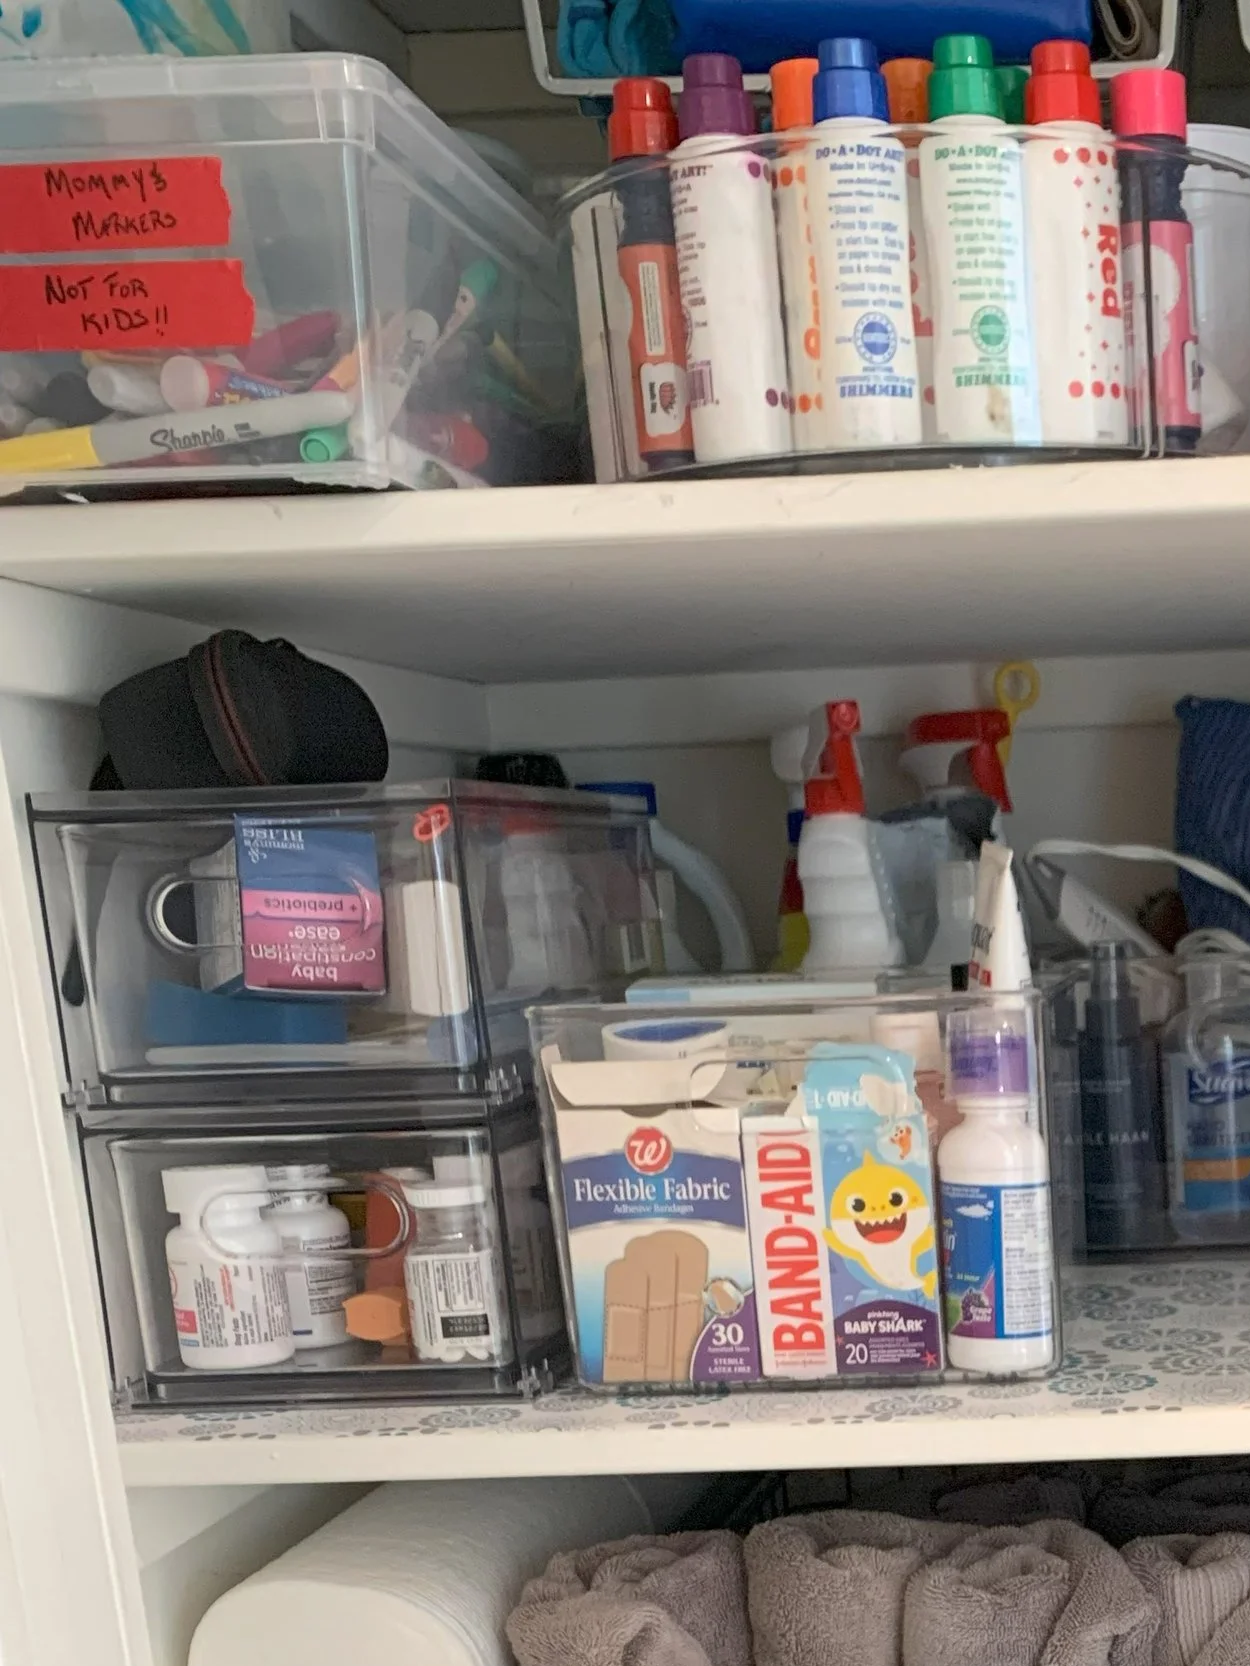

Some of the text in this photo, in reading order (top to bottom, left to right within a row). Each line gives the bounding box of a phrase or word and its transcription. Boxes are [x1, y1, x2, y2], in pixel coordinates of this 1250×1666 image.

[1097, 223, 1121, 319] Red
[45, 271, 149, 305] NOT FOR
[81, 305, 169, 337] KIDS!!
[263, 898, 344, 914] prebiotics
[291, 963, 338, 982] baby
[574, 1177, 731, 1202] Flexible Fabric
[756, 1133, 826, 1352] BAND-AID
[711, 1322, 744, 1346] 30
[843, 1316, 924, 1334] BABY SHARK
[845, 1342, 869, 1365] 20
